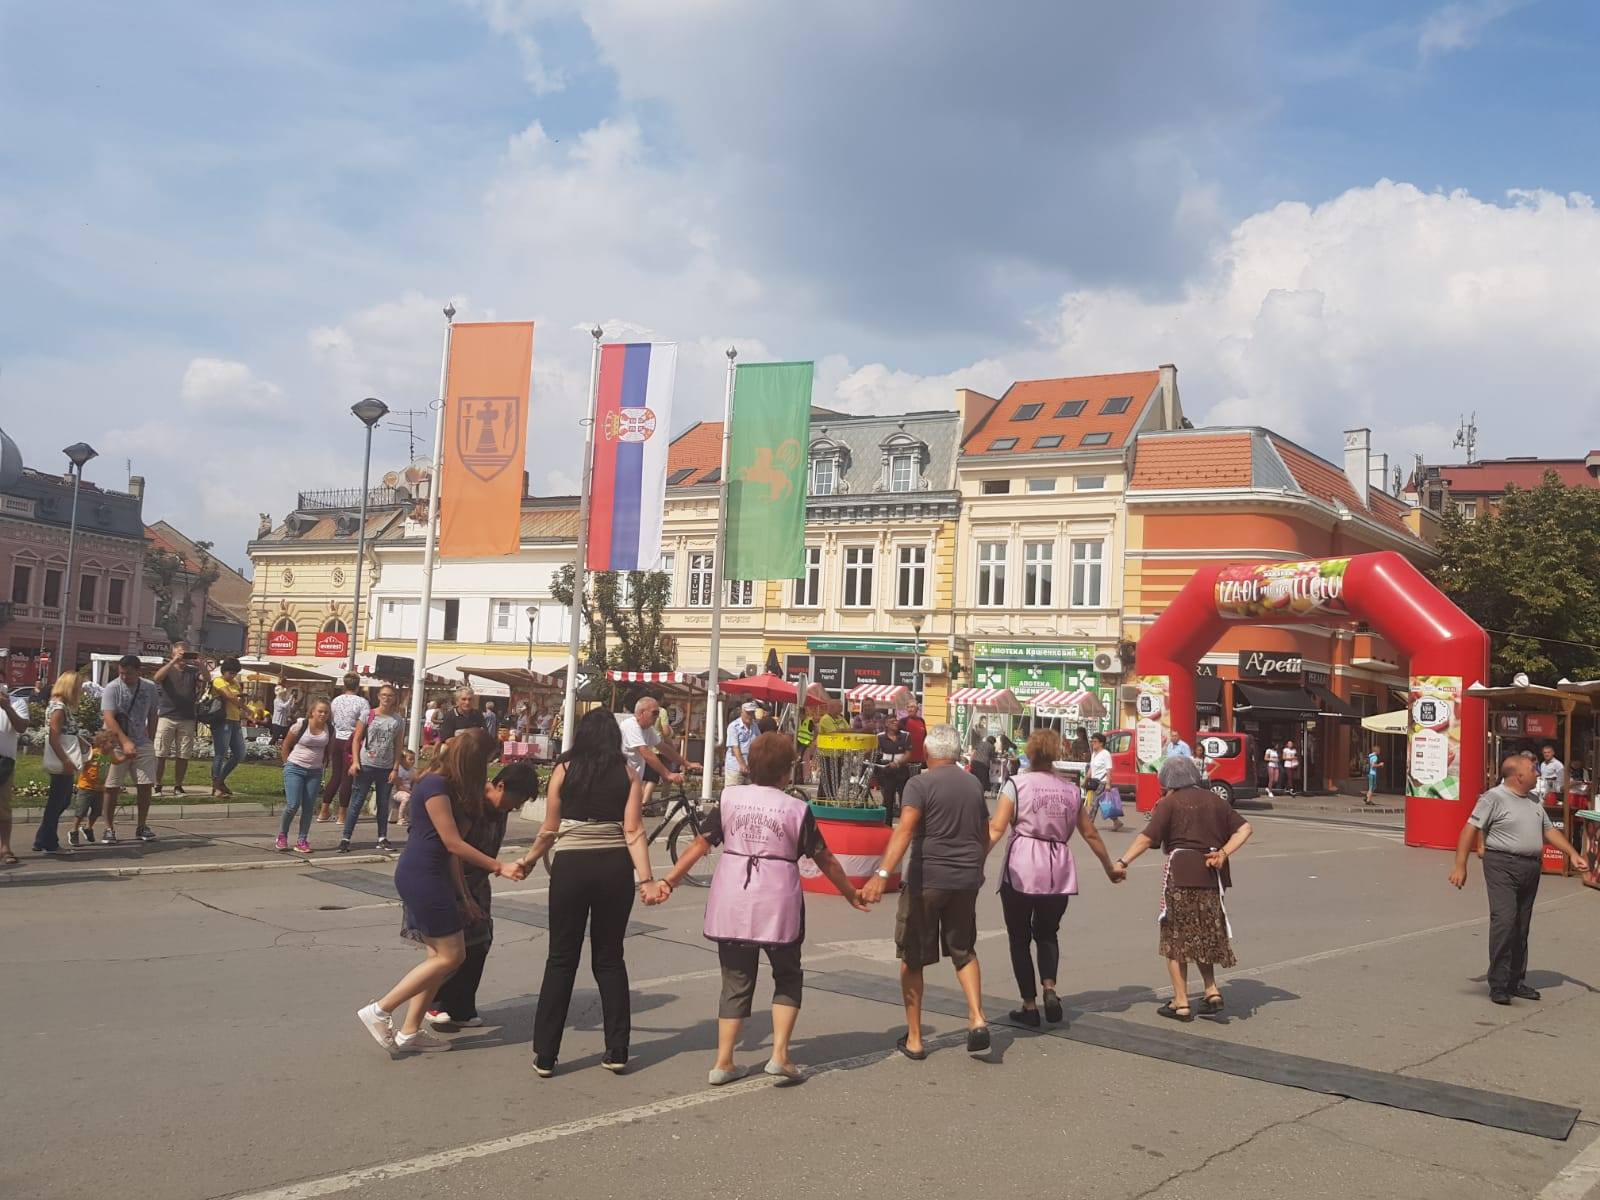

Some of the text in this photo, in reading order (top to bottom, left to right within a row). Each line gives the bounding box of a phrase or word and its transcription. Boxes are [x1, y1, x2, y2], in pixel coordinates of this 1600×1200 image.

[691, 573, 699, 604] STUDIO
[703, 573, 711, 604] LEPOTE
[1219, 579, 1258, 603] IZAĐI
[990, 647, 1024, 655] АПОТЕКА
[1507, 716, 1519, 727] VOX
